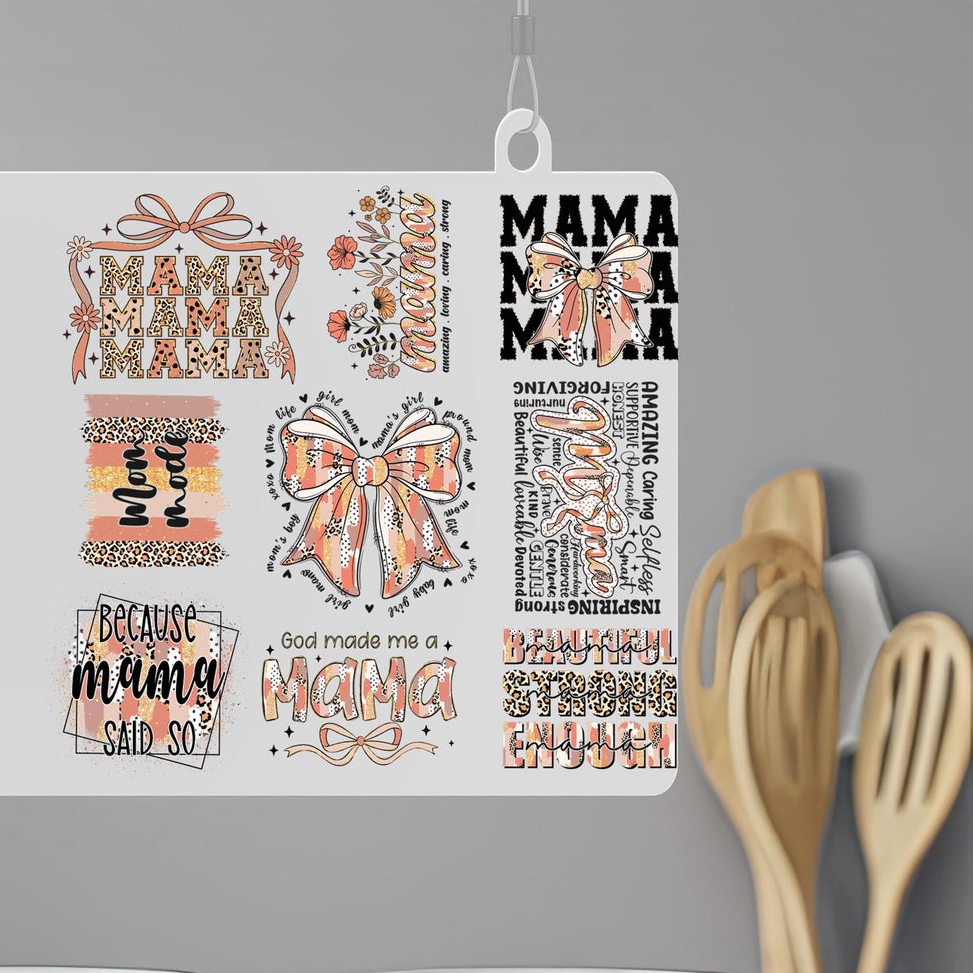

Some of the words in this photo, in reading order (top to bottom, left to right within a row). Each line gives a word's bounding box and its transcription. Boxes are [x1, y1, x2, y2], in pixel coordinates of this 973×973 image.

[441, 199, 451, 233] strong
[499, 194, 679, 249] MAMA
[99, 255, 271, 297] MAMA
[398, 191, 437, 373] mama
[441, 241, 451, 277] caring
[98, 296, 269, 338] MAMA
[441, 285, 452, 317] loving
[99, 338, 271, 379] MAMA
[441, 326, 452, 373] amazing
[513, 380, 610, 395] FORGIVING
[513, 411, 530, 476] Beautiful
[641, 381, 659, 465] AMAZING
[112, 427, 159, 527] Mom
[153, 426, 191, 528] mode
[641, 470, 658, 521] Caring
[514, 546, 527, 597] Devoted
[567, 598, 661, 615] INSPIRING
[281, 631, 317, 650] God
[324, 631, 380, 650] made
[388, 634, 418, 649] me
[425, 634, 437, 650] a
[504, 628, 677, 666] BEAUTIFUL
[70, 656, 226, 706] mama
[502, 669, 677, 718] STRONG
[102, 720, 154, 758] SAID
[167, 719, 197, 756] SO
[504, 721, 677, 770] ENOUGH
